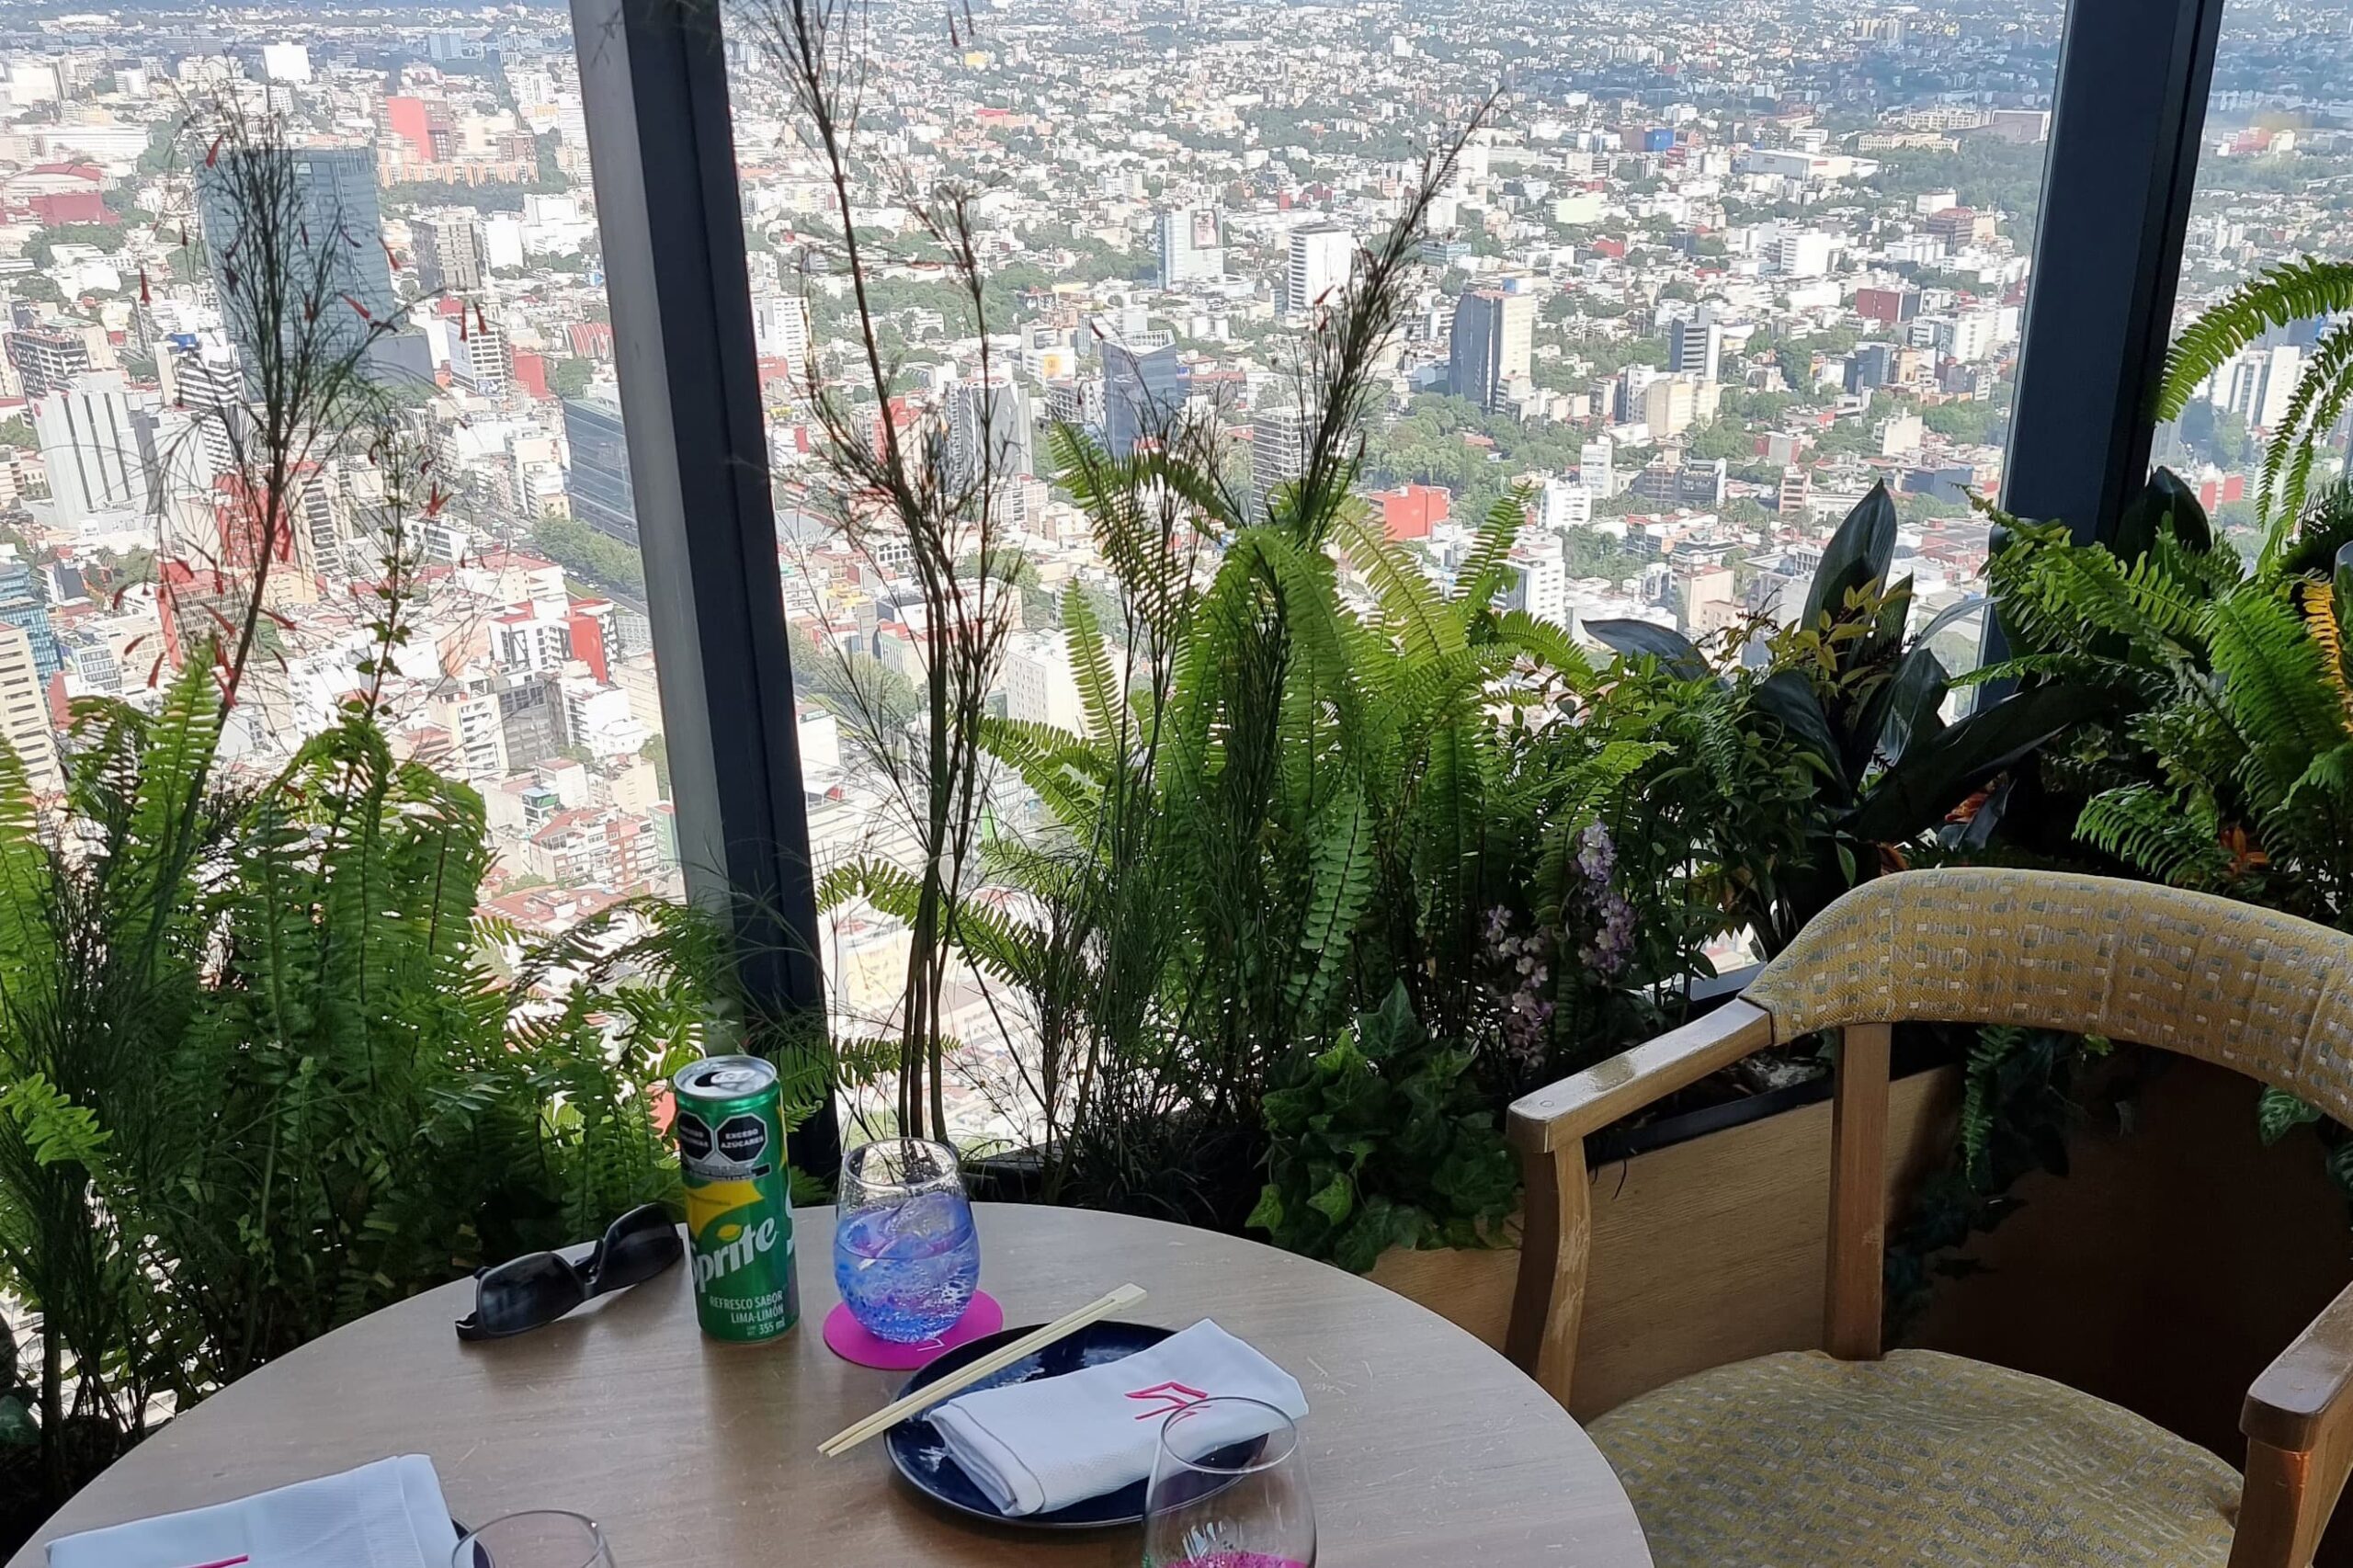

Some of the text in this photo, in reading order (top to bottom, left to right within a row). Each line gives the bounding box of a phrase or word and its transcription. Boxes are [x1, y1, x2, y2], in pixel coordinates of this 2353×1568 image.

[725, 1128, 758, 1140] EXCESO
[709, 1290, 783, 1310] REFRESCO SABOR
[731, 1303, 784, 1324] LIMA-LIMÓN
[758, 1322, 774, 1335] 355
[776, 1316, 785, 1331] ml
